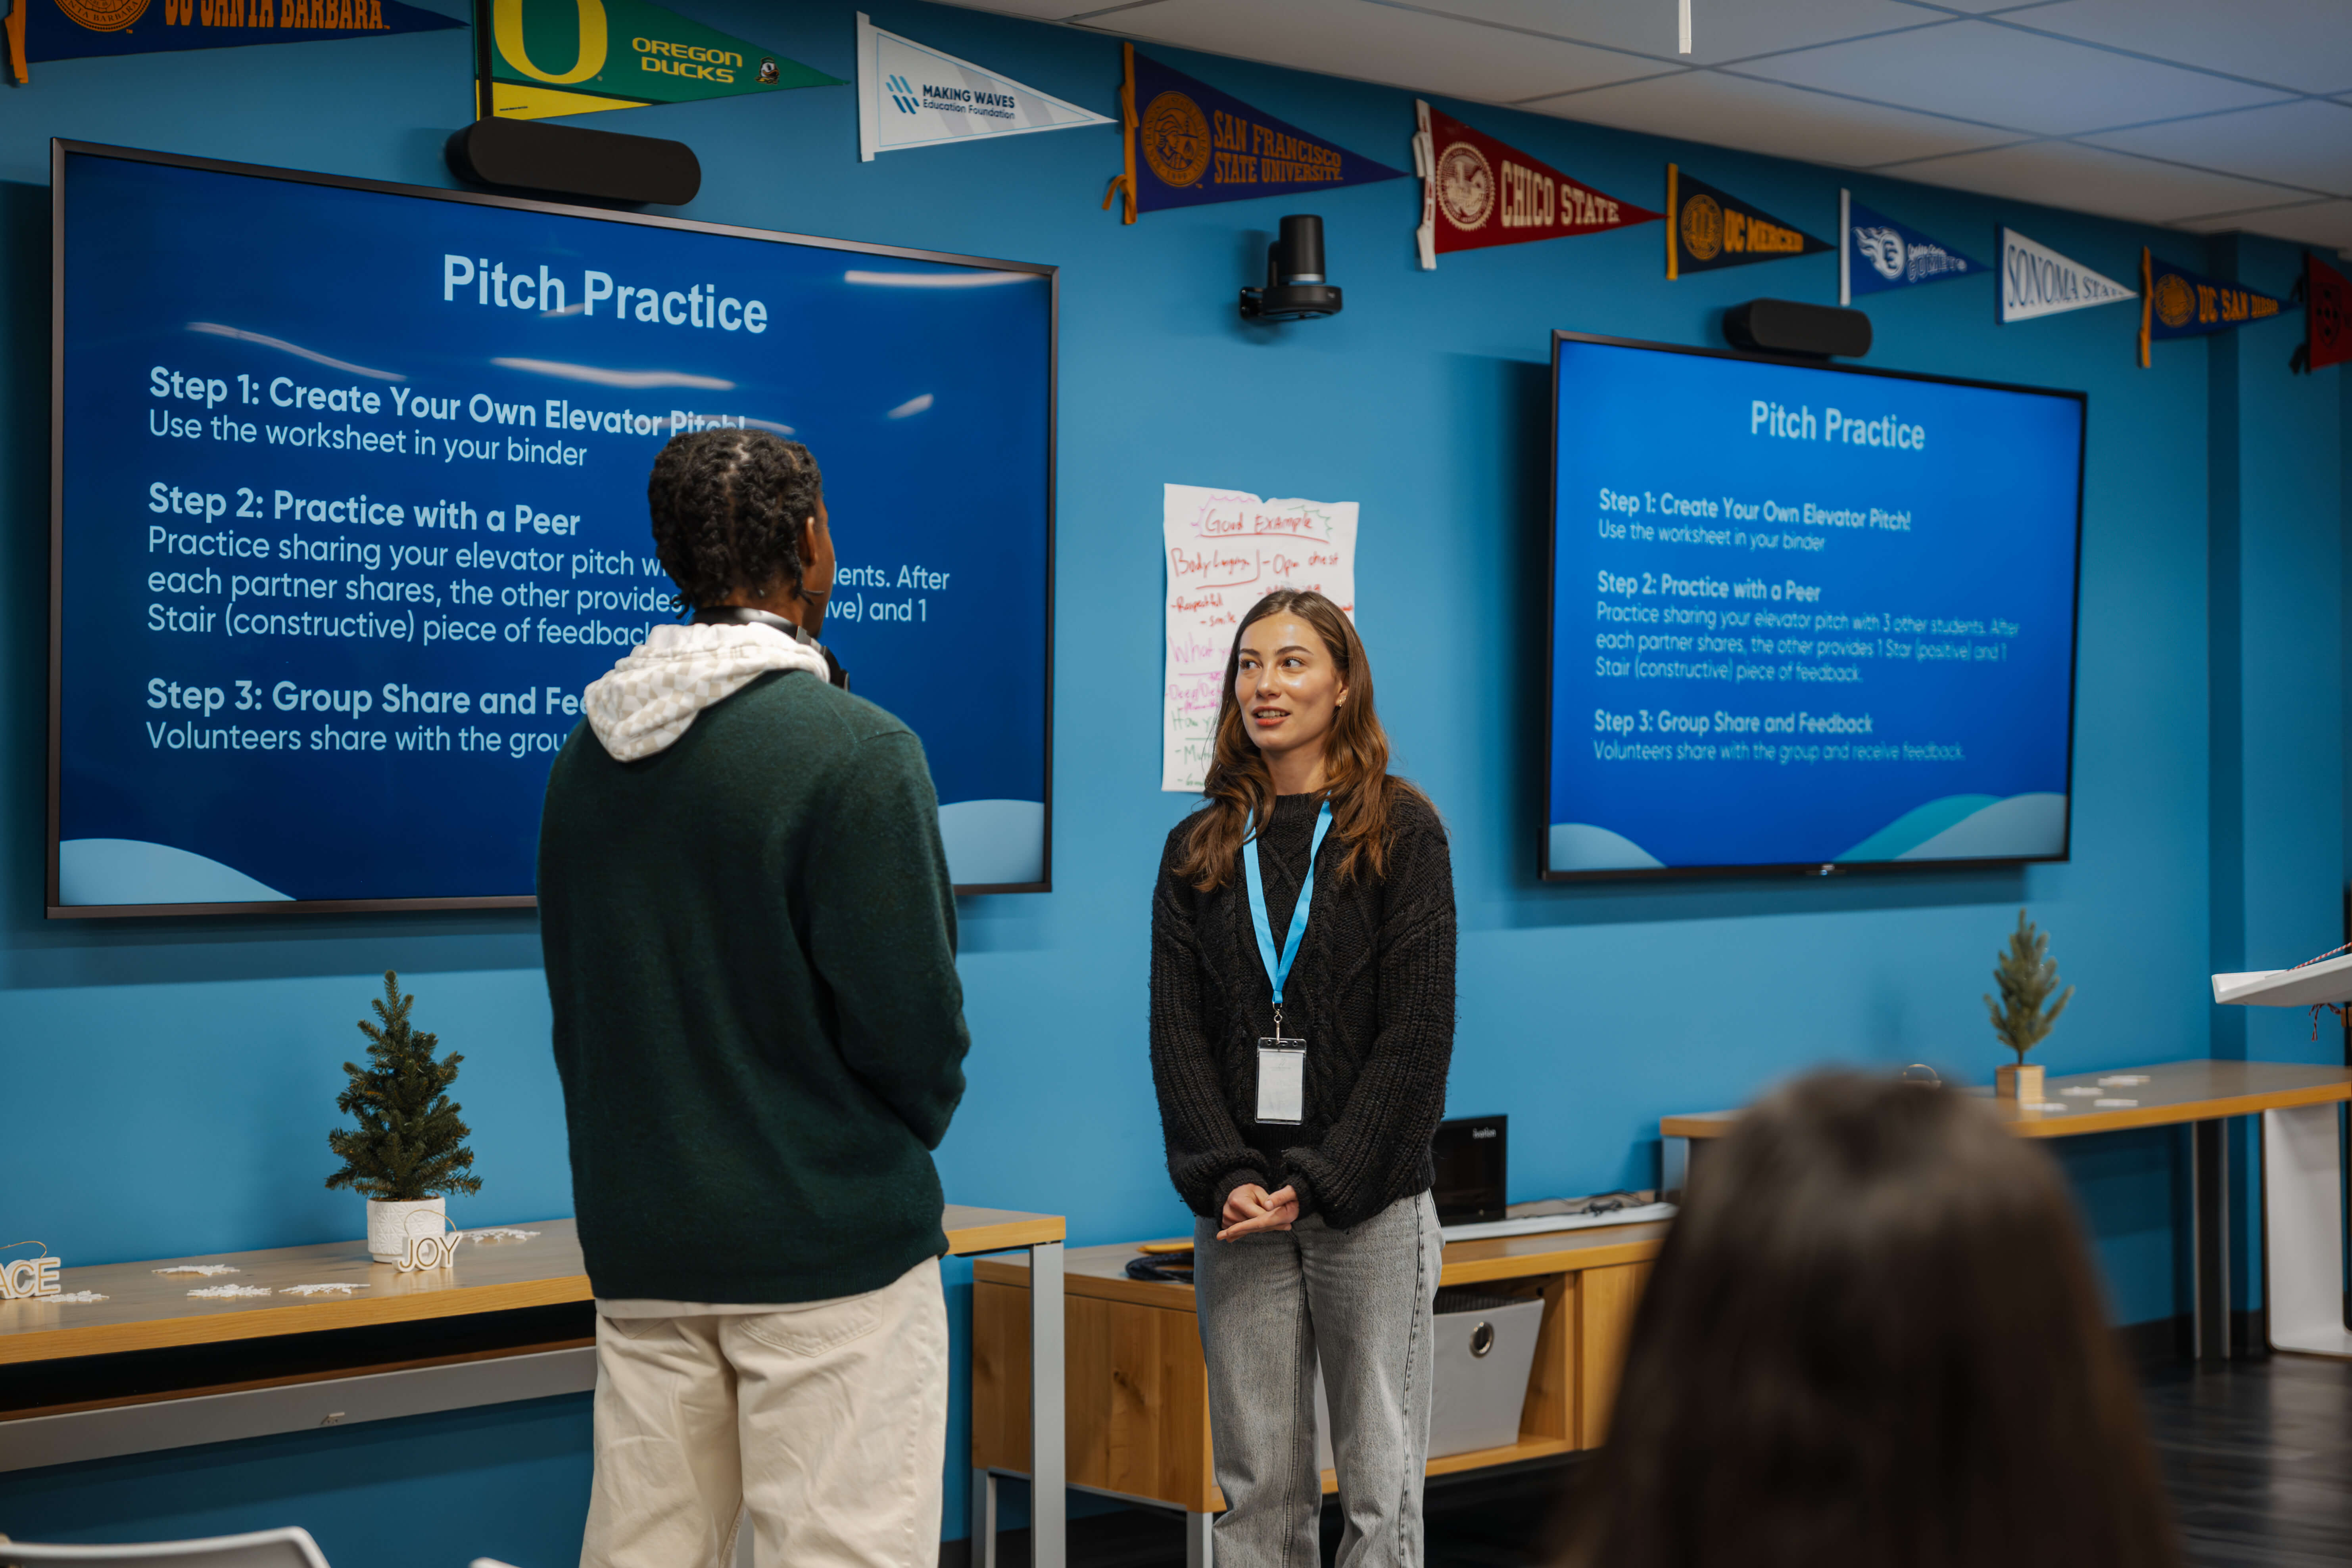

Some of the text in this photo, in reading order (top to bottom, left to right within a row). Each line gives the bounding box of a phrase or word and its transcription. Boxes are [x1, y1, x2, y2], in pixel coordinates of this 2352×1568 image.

[632, 36, 743, 69] OREGON
[641, 56, 735, 84] DUCKS
[923, 84, 1016, 109] MAKING WAVES
[923, 98, 1016, 120] Education Foundation
[1213, 109, 1247, 152] SAN
[1252, 123, 1342, 168] FRANCISCO
[1214, 151, 1340, 184] STATE UNIVERSITY
[1500, 159, 1555, 228] CHICO
[1561, 184, 1620, 225] STATE
[1723, 208, 1745, 253] UC
[444, 254, 768, 334] Pitch Practice
[2006, 244, 2079, 308] SONOMA
[2196, 284, 2218, 324] UC
[2221, 288, 2249, 321] SAN
[150, 366, 228, 409] Step
[237, 374, 259, 405] 1:
[270, 377, 381, 414] Create
[389, 386, 461, 420] Your
[469, 393, 536, 426] Own
[546, 399, 662, 436] Elevator
[150, 409, 587, 466] Use the worksheet in your binder
[1752, 400, 1926, 451] Pitch Practice
[149, 482, 580, 535] Step 2: Practice with a Peer
[1205, 508, 1243, 534] Good
[1599, 487, 1911, 531] Step 1: Create Your Own Elevator Pitch!
[149, 526, 269, 558] Practice
[278, 533, 380, 570] sharing
[390, 545, 448, 570] your
[456, 541, 564, 572] elevator
[572, 549, 634, 579] pitch
[1599, 518, 1826, 552] Use the worksheet in your binder
[148, 567, 683, 615] each partner shares, the other provides
[897, 564, 950, 590] After
[1597, 570, 1822, 603] Step 2: Practice with a Peer
[148, 603, 650, 646] Stair (constructive) piece of feedbac
[869, 598, 912, 622] and
[918, 598, 927, 622] 1
[1597, 601, 1660, 624] Practice
[1663, 604, 1717, 631] sharing
[1721, 611, 1751, 630] your
[1755, 607, 1812, 630] elevator
[1814, 610, 1849, 632] pitch
[1853, 611, 1880, 632] with
[1883, 613, 1891, 632] 3
[1893, 614, 1927, 633] other
[1596, 626, 1635, 650] each
[1638, 634, 1693, 654] partner
[1697, 633, 1748, 655] shares,
[1751, 635, 1775, 654] the
[1777, 636, 1814, 655] other
[1817, 636, 1874, 660] provides
[1886, 638, 1912, 659] Star
[1974, 642, 1999, 660] and
[1596, 656, 1631, 677] Stair
[1635, 654, 1732, 681] (constructive)
[1736, 660, 1775, 684] piece
[1778, 661, 1793, 681] of
[147, 678, 225, 717] Step
[235, 680, 262, 710] 3:
[273, 681, 372, 719] Group
[382, 683, 470, 714] Share
[480, 687, 536, 714] and
[146, 721, 568, 758] Volunteers share with the grou
[1594, 709, 1874, 737] Step 3: Group Share and Feedback
[1594, 739, 1672, 760] Volunteers
[1677, 741, 1716, 760] share
[1719, 740, 1750, 760] with
[1752, 741, 1776, 760] the
[1779, 745, 1820, 765] group
[1824, 741, 1851, 760] and
[397, 1230, 463, 1272] JOY
